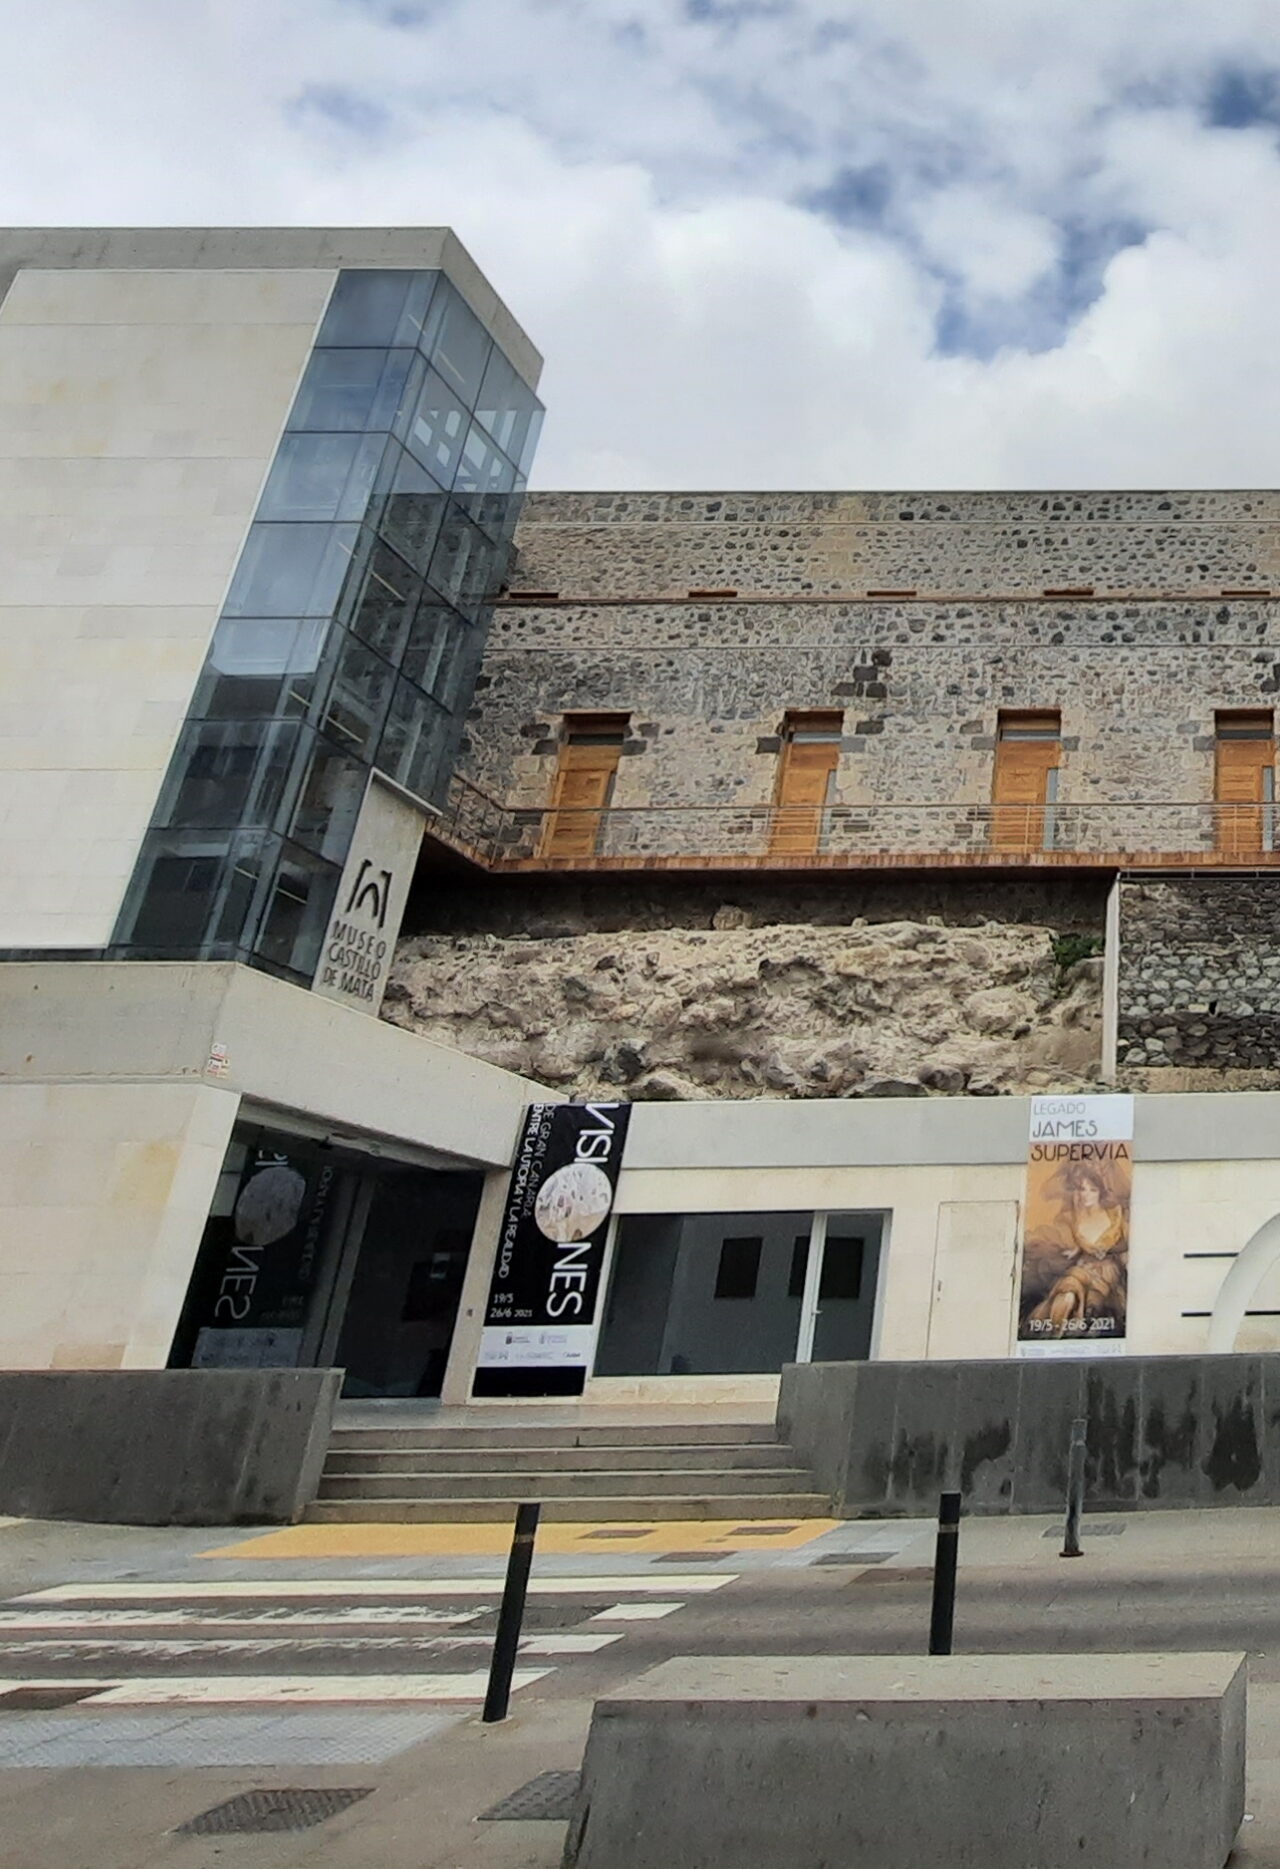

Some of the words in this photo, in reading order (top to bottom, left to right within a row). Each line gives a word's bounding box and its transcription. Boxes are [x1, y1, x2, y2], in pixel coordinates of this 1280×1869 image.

[331, 920, 386, 959] MUSEO
[328, 942, 381, 981] CASTILLO
[323, 967, 338, 986] DE
[338, 972, 374, 1002] MATA
[543, 1103, 557, 1120] DE
[1033, 1102, 1086, 1116] LEGADO
[527, 1103, 545, 1136] ENTRE
[1032, 1120, 1098, 1138] JAMES
[523, 1137, 537, 1153] LA
[534, 1122, 552, 1157] GRAN
[1031, 1143, 1129, 1161] SUPERVIA
[512, 1196, 523, 1205] Y
[508, 1206, 521, 1222] LA
[499, 1223, 518, 1278] REALIDAD
[494, 1293, 514, 1304] 19/5
[490, 1307, 512, 1318] 26/6
[1029, 1318, 1053, 1331] 19/5
[1062, 1318, 1087, 1331] 26/6
[1089, 1317, 1115, 1330] 2021
